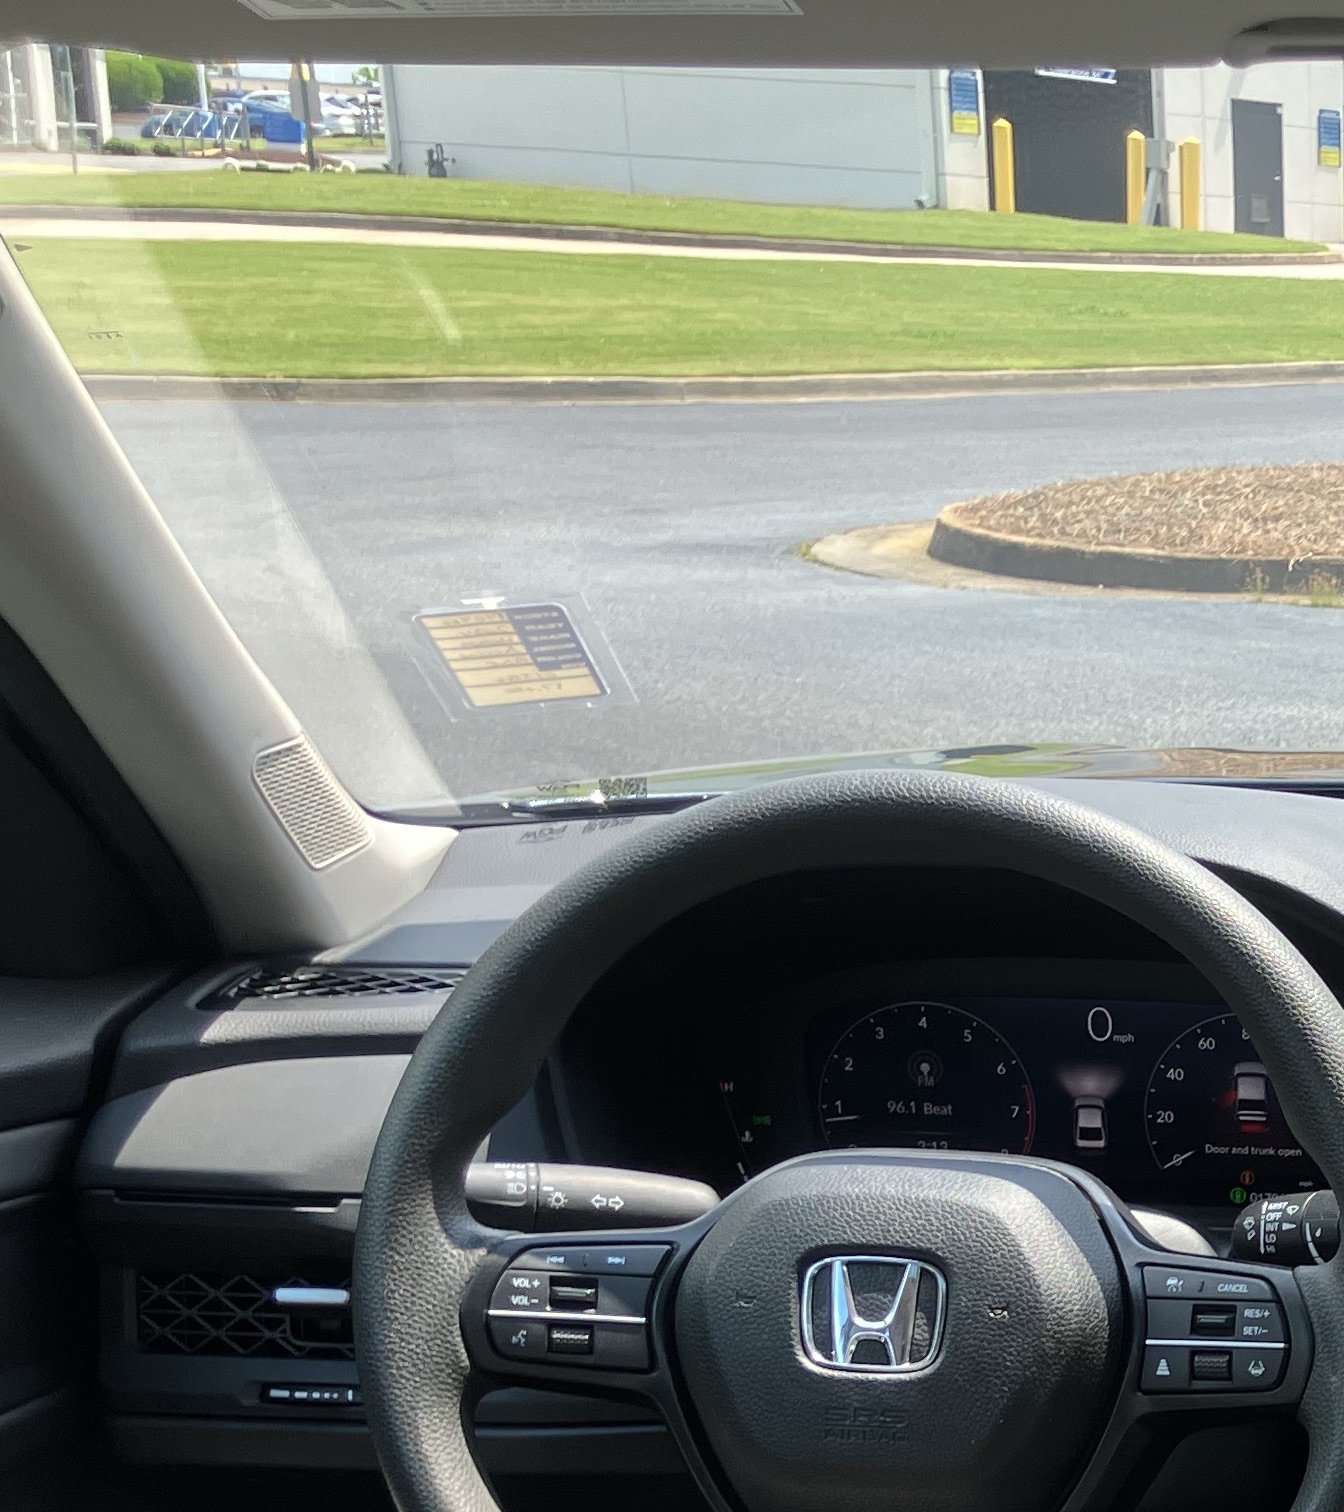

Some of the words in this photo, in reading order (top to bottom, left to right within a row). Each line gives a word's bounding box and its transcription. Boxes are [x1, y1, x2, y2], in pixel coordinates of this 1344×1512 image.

[918, 1017, 928, 1030] 4
[1087, 1006, 1113, 1042] 0
[1113, 1033, 1135, 1044] mph
[875, 1027, 884, 1040] 3
[963, 1030, 973, 1042] 5
[1198, 1037, 1216, 1050] 60
[844, 1058, 854, 1071] 2
[997, 1063, 1006, 1075] 6
[1166, 1068, 1184, 1081] 40
[835, 1100, 842, 1114] 1
[887, 1101, 917, 1114] 96.1
[923, 1103, 953, 1116] Beat
[1011, 1106, 1020, 1118] 7
[1156, 1110, 1174, 1123] 20
[1205, 1144, 1229, 1154] Door
[1231, 1146, 1249, 1155] and
[1251, 1146, 1276, 1156] trunk
[1278, 1148, 1302, 1157] open
[1266, 1212, 1283, 1221] OFF
[1217, 1283, 1248, 1293] CANCEL
